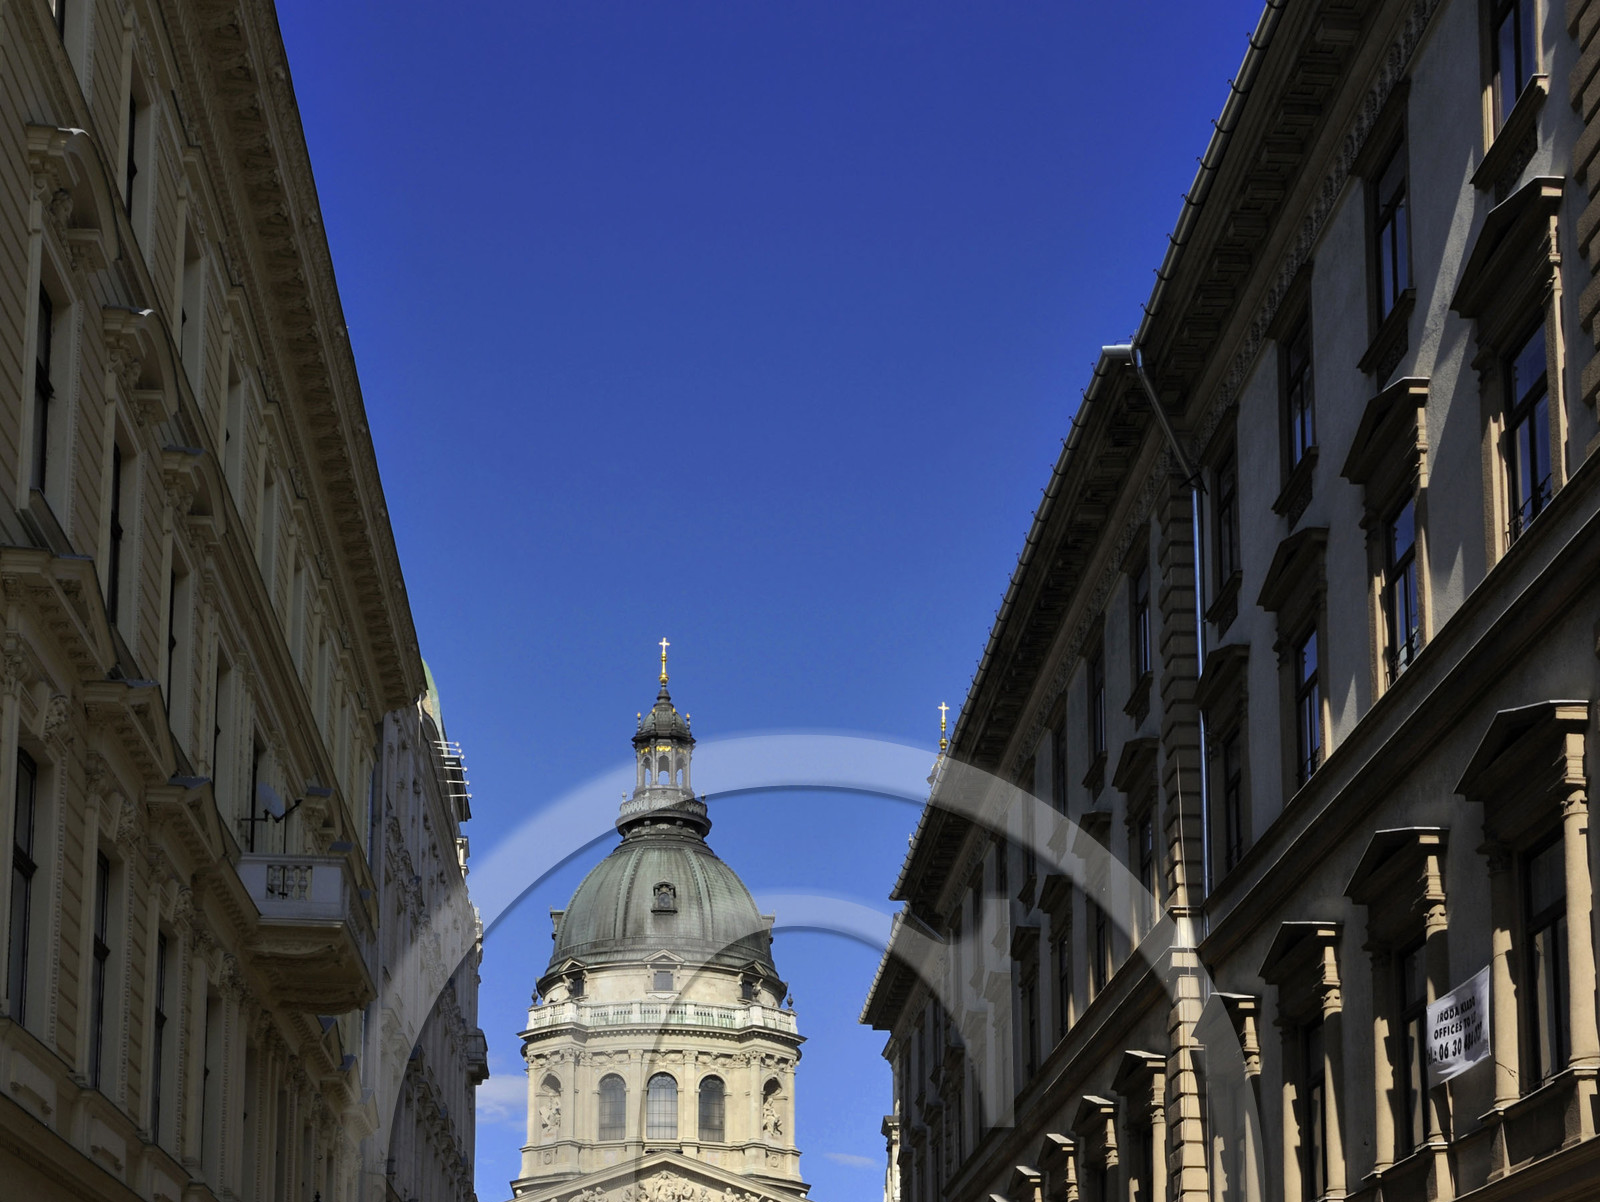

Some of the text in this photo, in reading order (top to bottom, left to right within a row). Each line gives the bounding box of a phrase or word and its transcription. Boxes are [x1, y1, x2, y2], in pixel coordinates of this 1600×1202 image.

[1437, 1006, 1460, 1023] IRODA
[1434, 1021, 1462, 1040] OFFICES
[1463, 1017, 1471, 1029] TO
[1439, 1041, 1449, 1061] 06
[1452, 1037, 1462, 1057] 30
